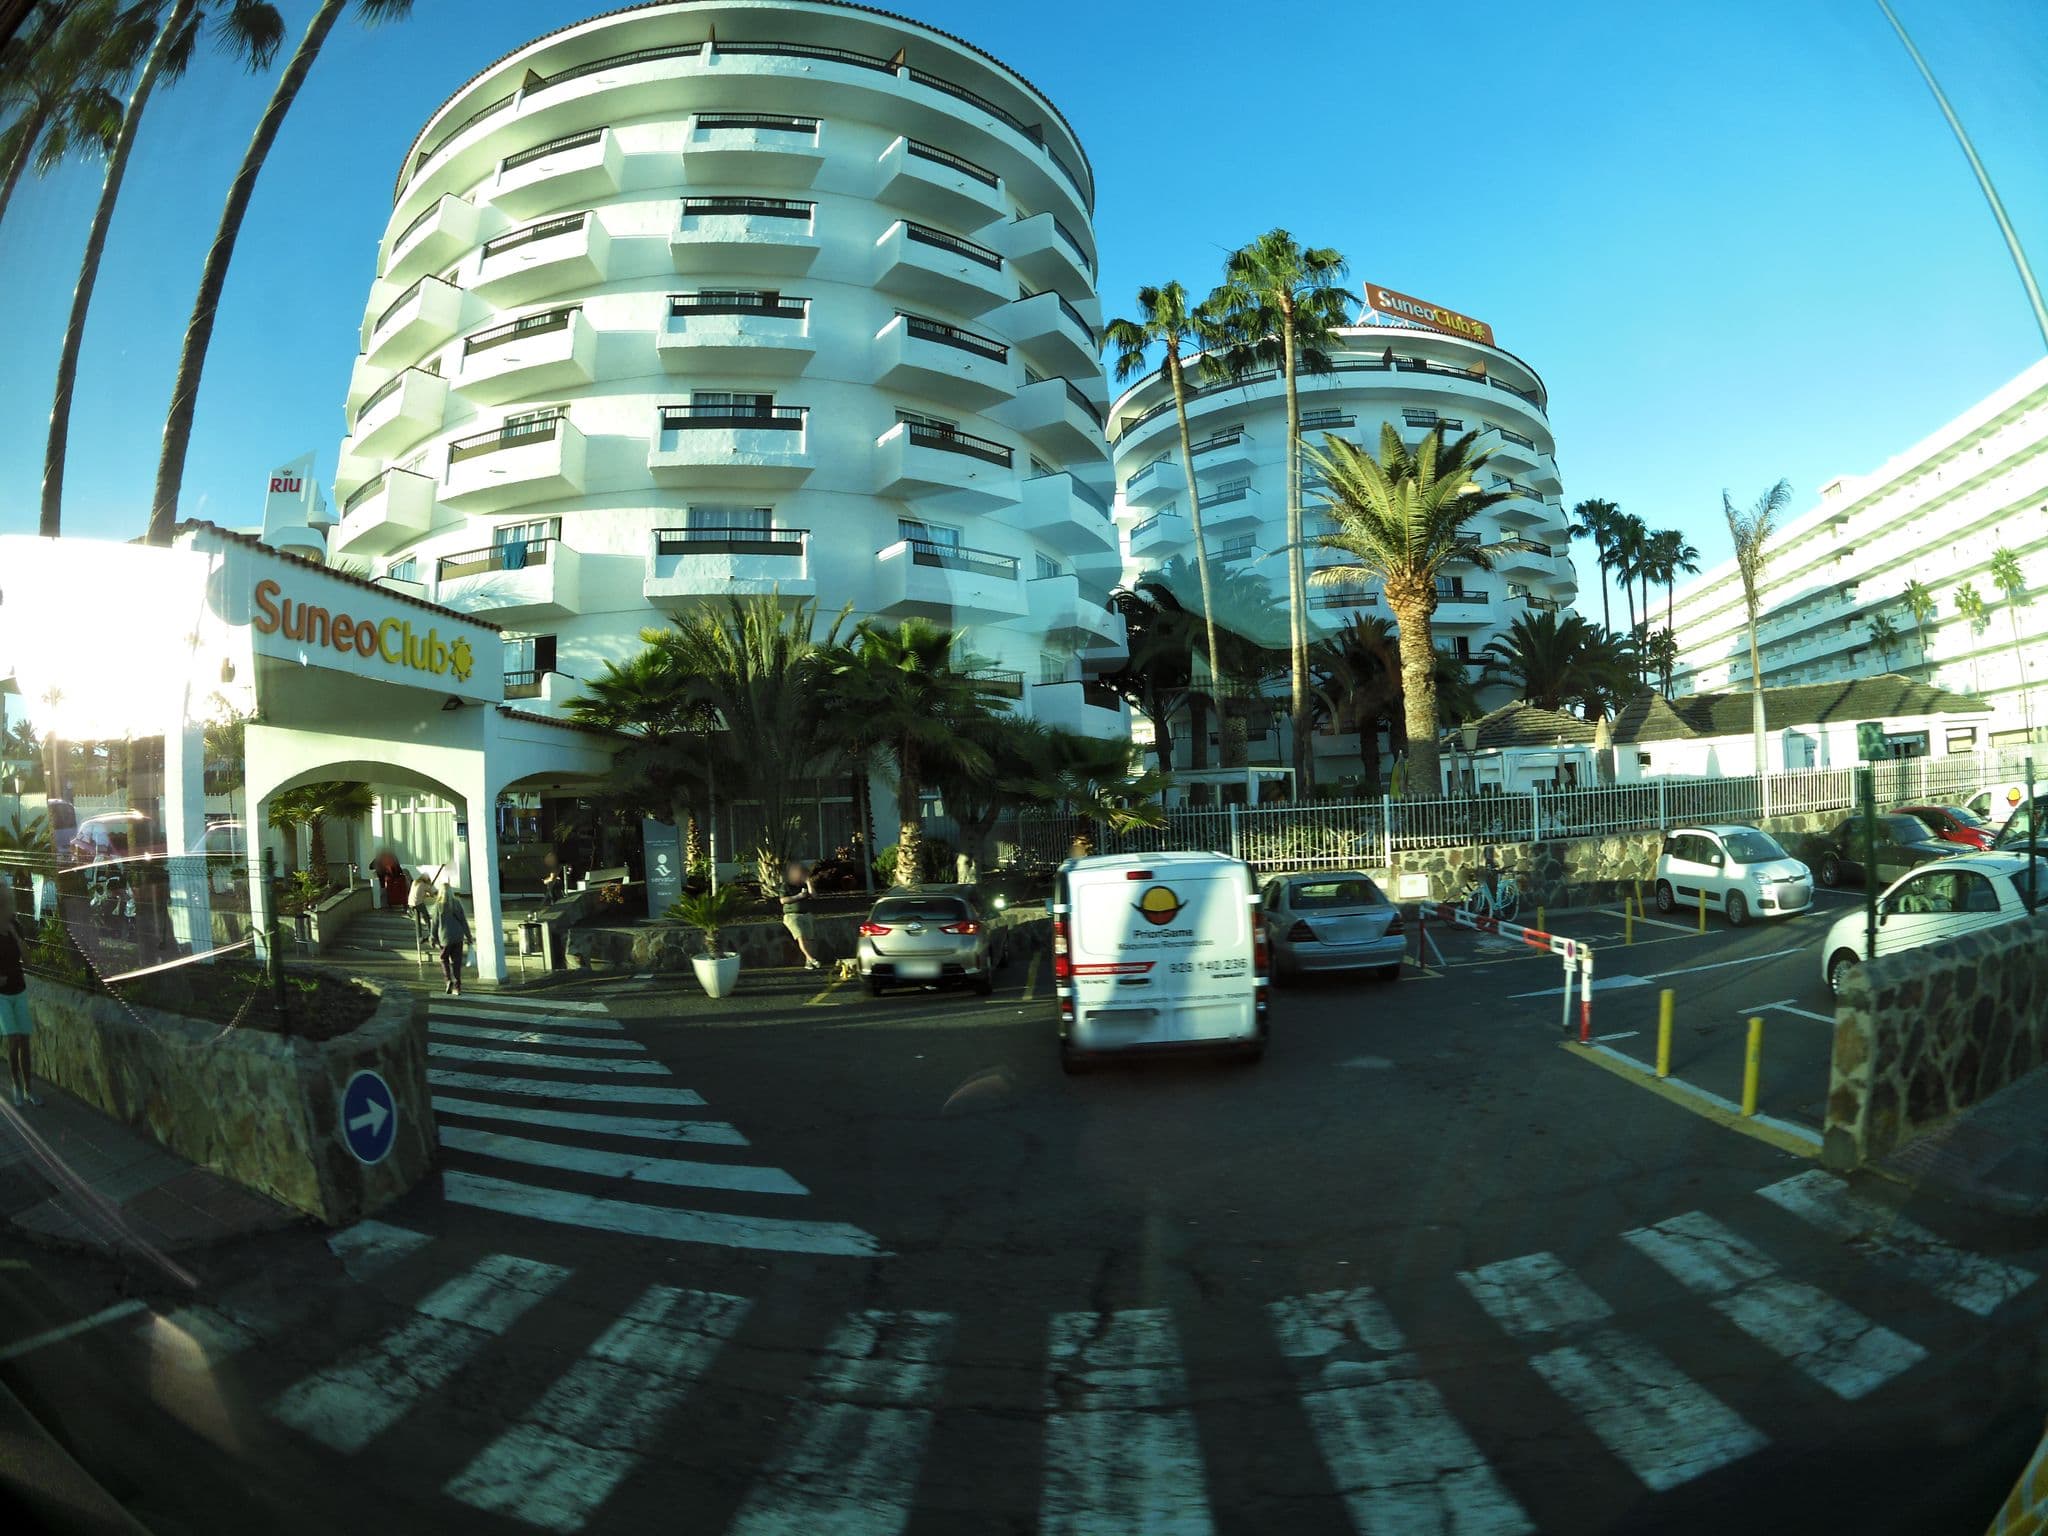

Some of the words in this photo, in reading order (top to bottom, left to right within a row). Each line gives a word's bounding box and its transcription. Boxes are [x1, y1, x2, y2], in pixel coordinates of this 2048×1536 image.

[1378, 291, 1470, 333] SuneoClub
[270, 478, 301, 493] RIU
[253, 579, 449, 675] SuneoClub
[1197, 960, 1222, 970] 140
[1223, 958, 1248, 969] 236
